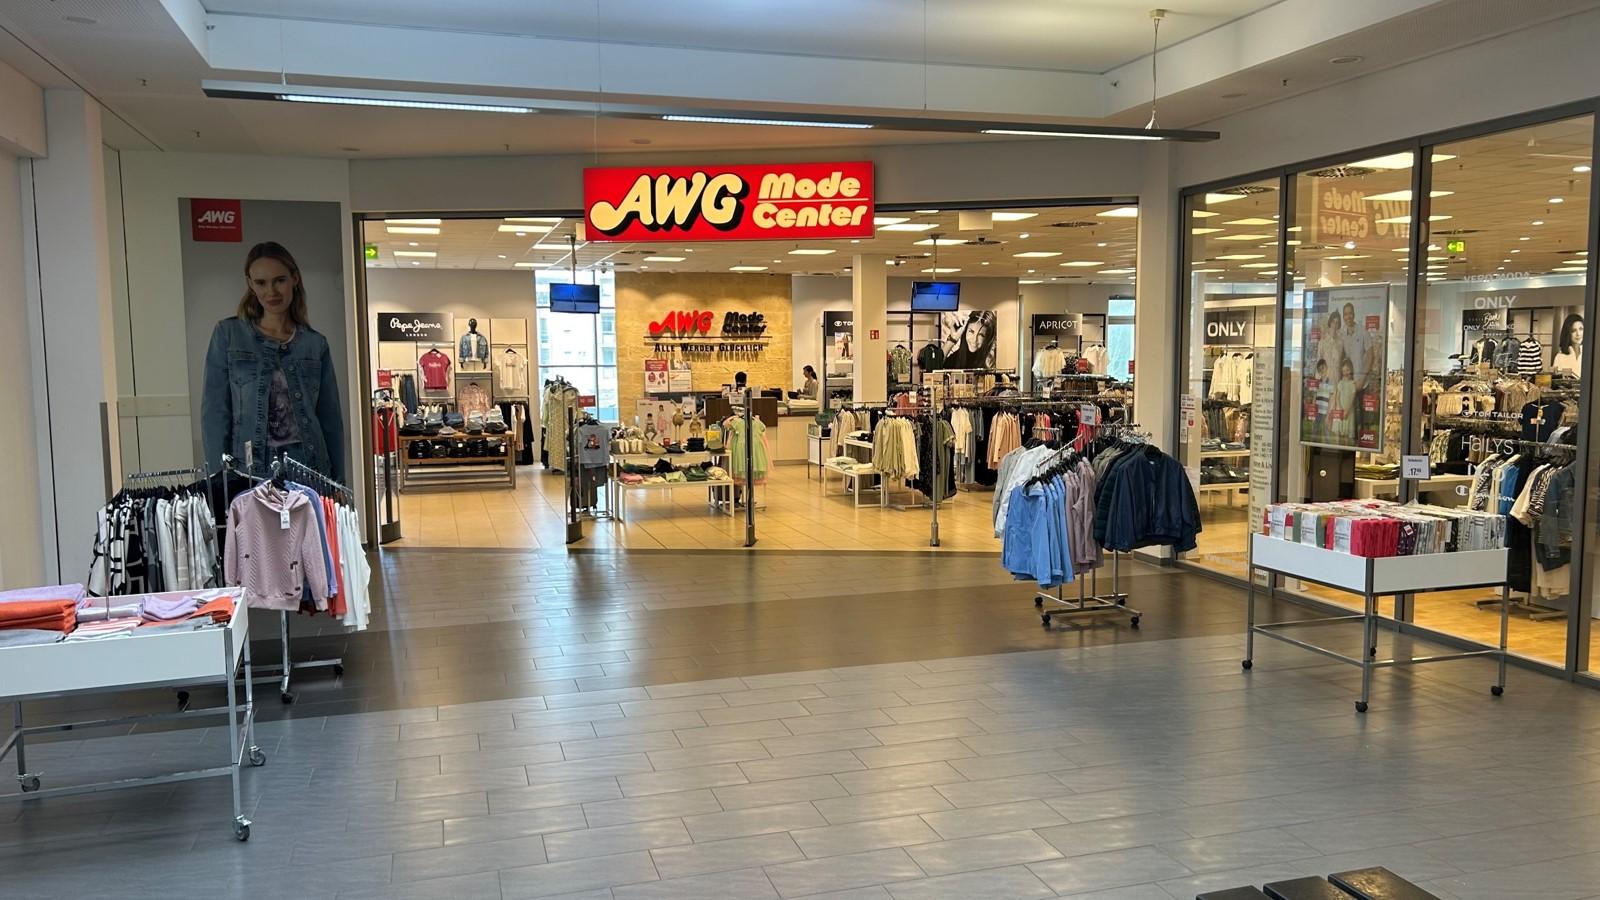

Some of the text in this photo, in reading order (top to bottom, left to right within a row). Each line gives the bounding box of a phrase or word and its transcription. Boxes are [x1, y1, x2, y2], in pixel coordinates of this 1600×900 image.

[758, 171, 861, 199] Mode
[588, 171, 747, 234] AWG
[197, 210, 236, 224] AWG
[752, 203, 868, 229] Center
[1474, 296, 1516, 309] ONLY
[390, 317, 442, 333] Pepe Jeans
[649, 310, 714, 334] AWG
[724, 311, 764, 323] Mode
[1039, 319, 1078, 330] APRICOT
[1207, 321, 1246, 338] ONLY
[1473, 410, 1524, 420] TOM TAILOR
